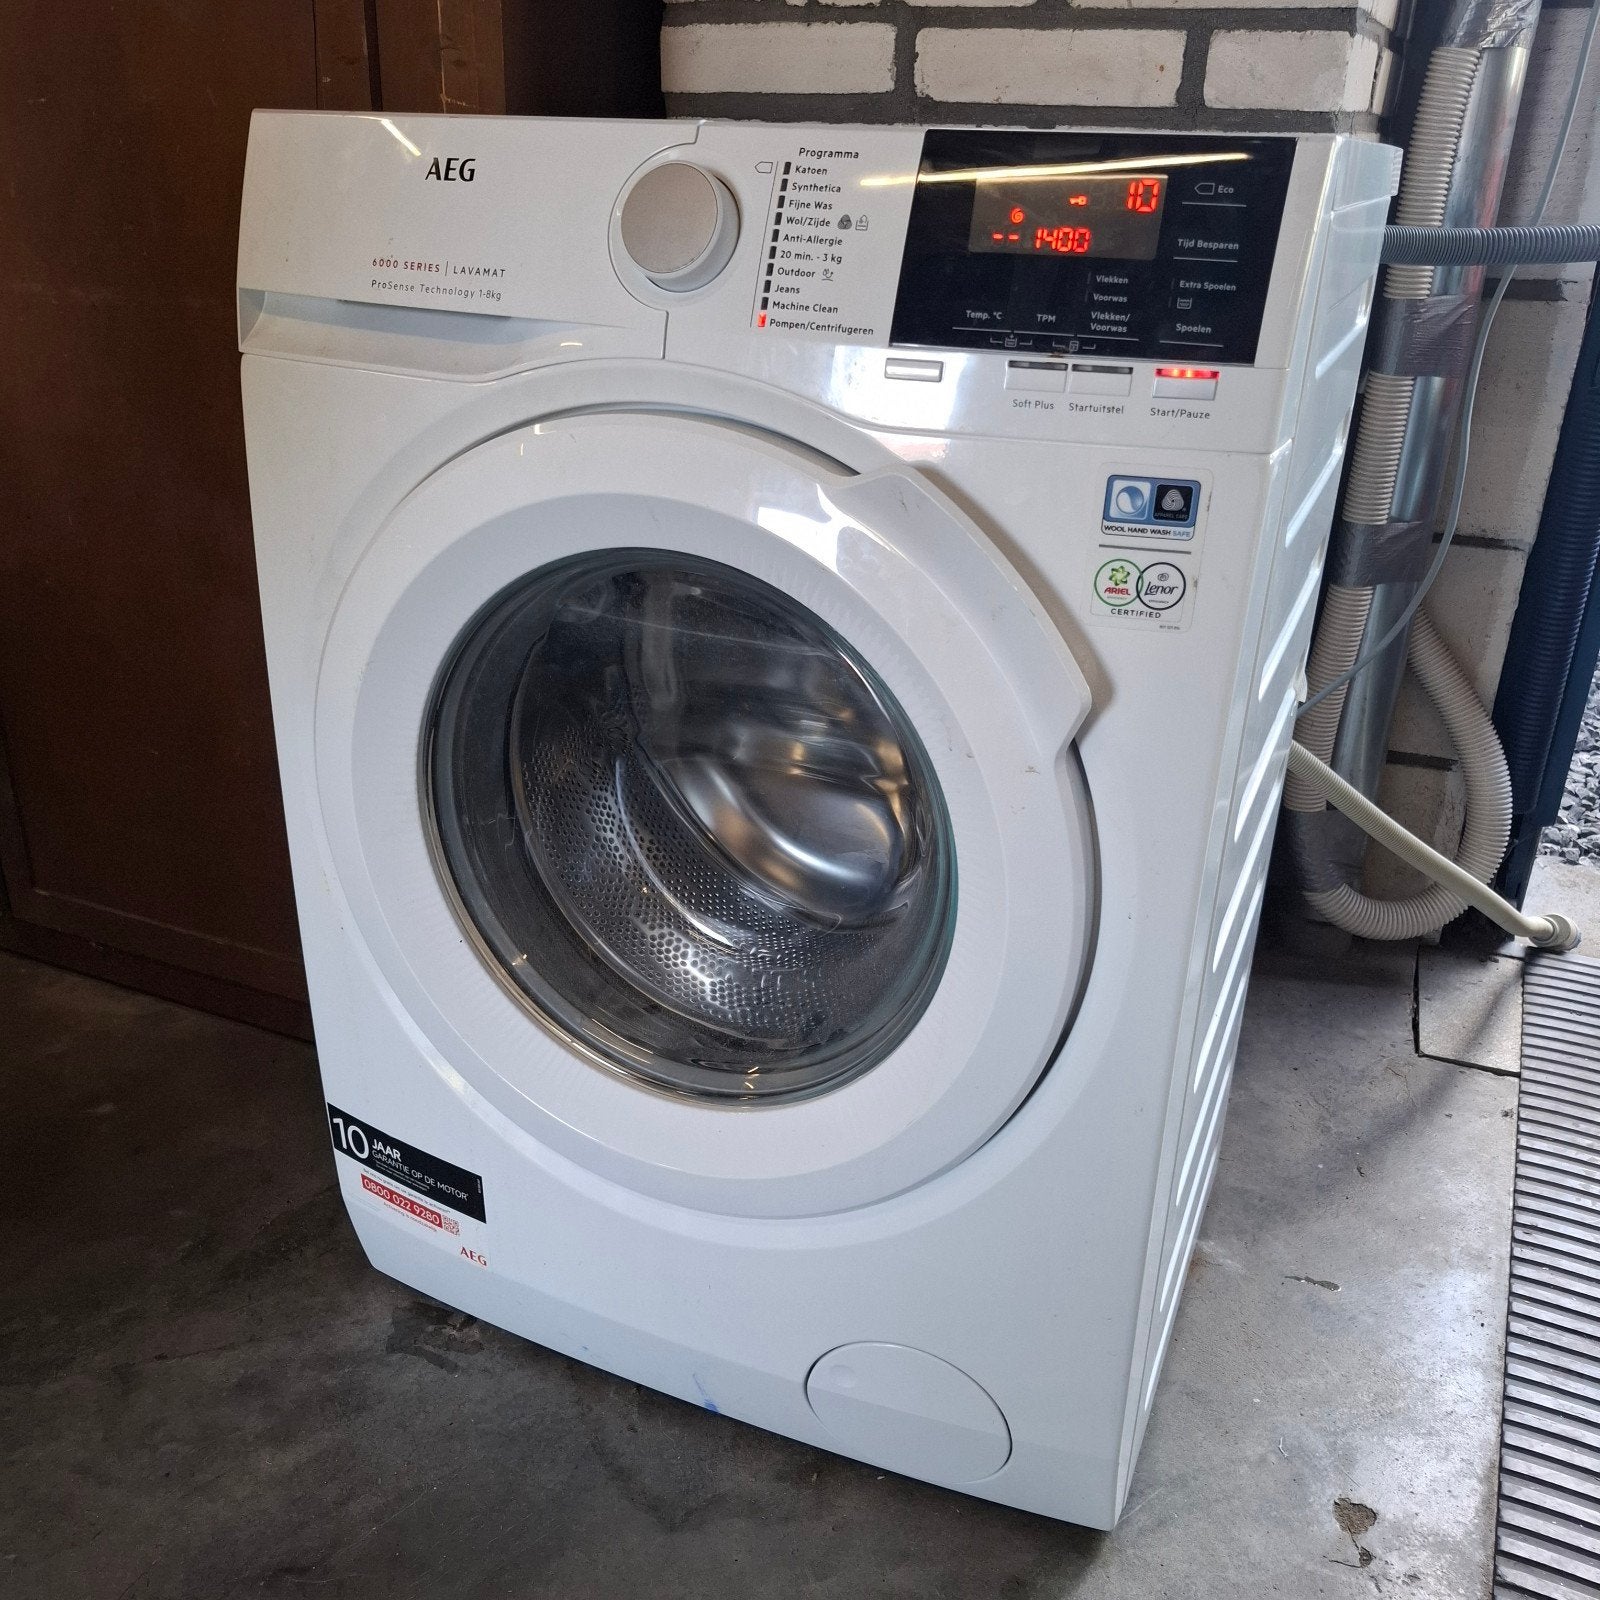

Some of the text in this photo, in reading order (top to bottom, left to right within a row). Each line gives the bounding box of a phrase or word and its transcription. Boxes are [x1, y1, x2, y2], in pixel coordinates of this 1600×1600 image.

[799, 147, 859, 159] Programma
[425, 157, 476, 182] AEG
[794, 165, 828, 176] Katoen
[791, 182, 841, 193] Synthetica
[1217, 185, 1235, 194] Eco
[1127, 178, 1160, 213] 10
[788, 199, 833, 211] Fijne Was
[786, 216, 831, 228] Wol/Zijde
[782, 233, 843, 247] Anti-Allergie
[1035, 226, 1091, 253] 1400
[1177, 238, 1239, 251] Tijd Besparen
[779, 250, 792, 259] 20
[794, 251, 814, 261] min.
[823, 253, 828, 262] 3
[831, 253, 842, 264] kg
[372, 258, 506, 278] 6000 SERIES LAVAMAT
[777, 267, 816, 278] Outdoor
[1096, 275, 1129, 285] Vlekken
[1179, 280, 1236, 292] Extra Spoelen
[371, 279, 501, 301] ProSense Technology 1-8kg
[774, 284, 801, 294] Jeans
[1093, 293, 1128, 303] Voorwas
[772, 301, 838, 313] Machine Clean
[966, 310, 991, 320] Temp.
[1036, 313, 1056, 323] TPM
[1090, 311, 1131, 322] Vlekken/
[769, 318, 874, 336] Pompen/Centrifugeren
[1090, 323, 1128, 333] Voorwas
[1175, 323, 1212, 334] Spoelen
[1012, 398, 1055, 410] Soft Plus
[1068, 402, 1124, 415] Startuitstel
[1150, 407, 1211, 420] Start/Pauze
[1104, 525, 1126, 533] WOOL
[1150, 528, 1171, 536] WASH
[1172, 530, 1191, 538] SAFE
[1104, 586, 1131, 596] ARIEL
[1144, 581, 1179, 596] Lenor
[1110, 608, 1162, 619] CERTIFIED
[333, 1117, 401, 1162] 10 JAAR
[372, 1150, 410, 1174] GARANTIE
[411, 1169, 423, 1180] OP
[425, 1175, 436, 1186] DE
[364, 1179, 391, 1199] 0800
[392, 1194, 412, 1211] 022
[414, 1204, 440, 1224] 9280
[460, 1246, 487, 1267] AEG
